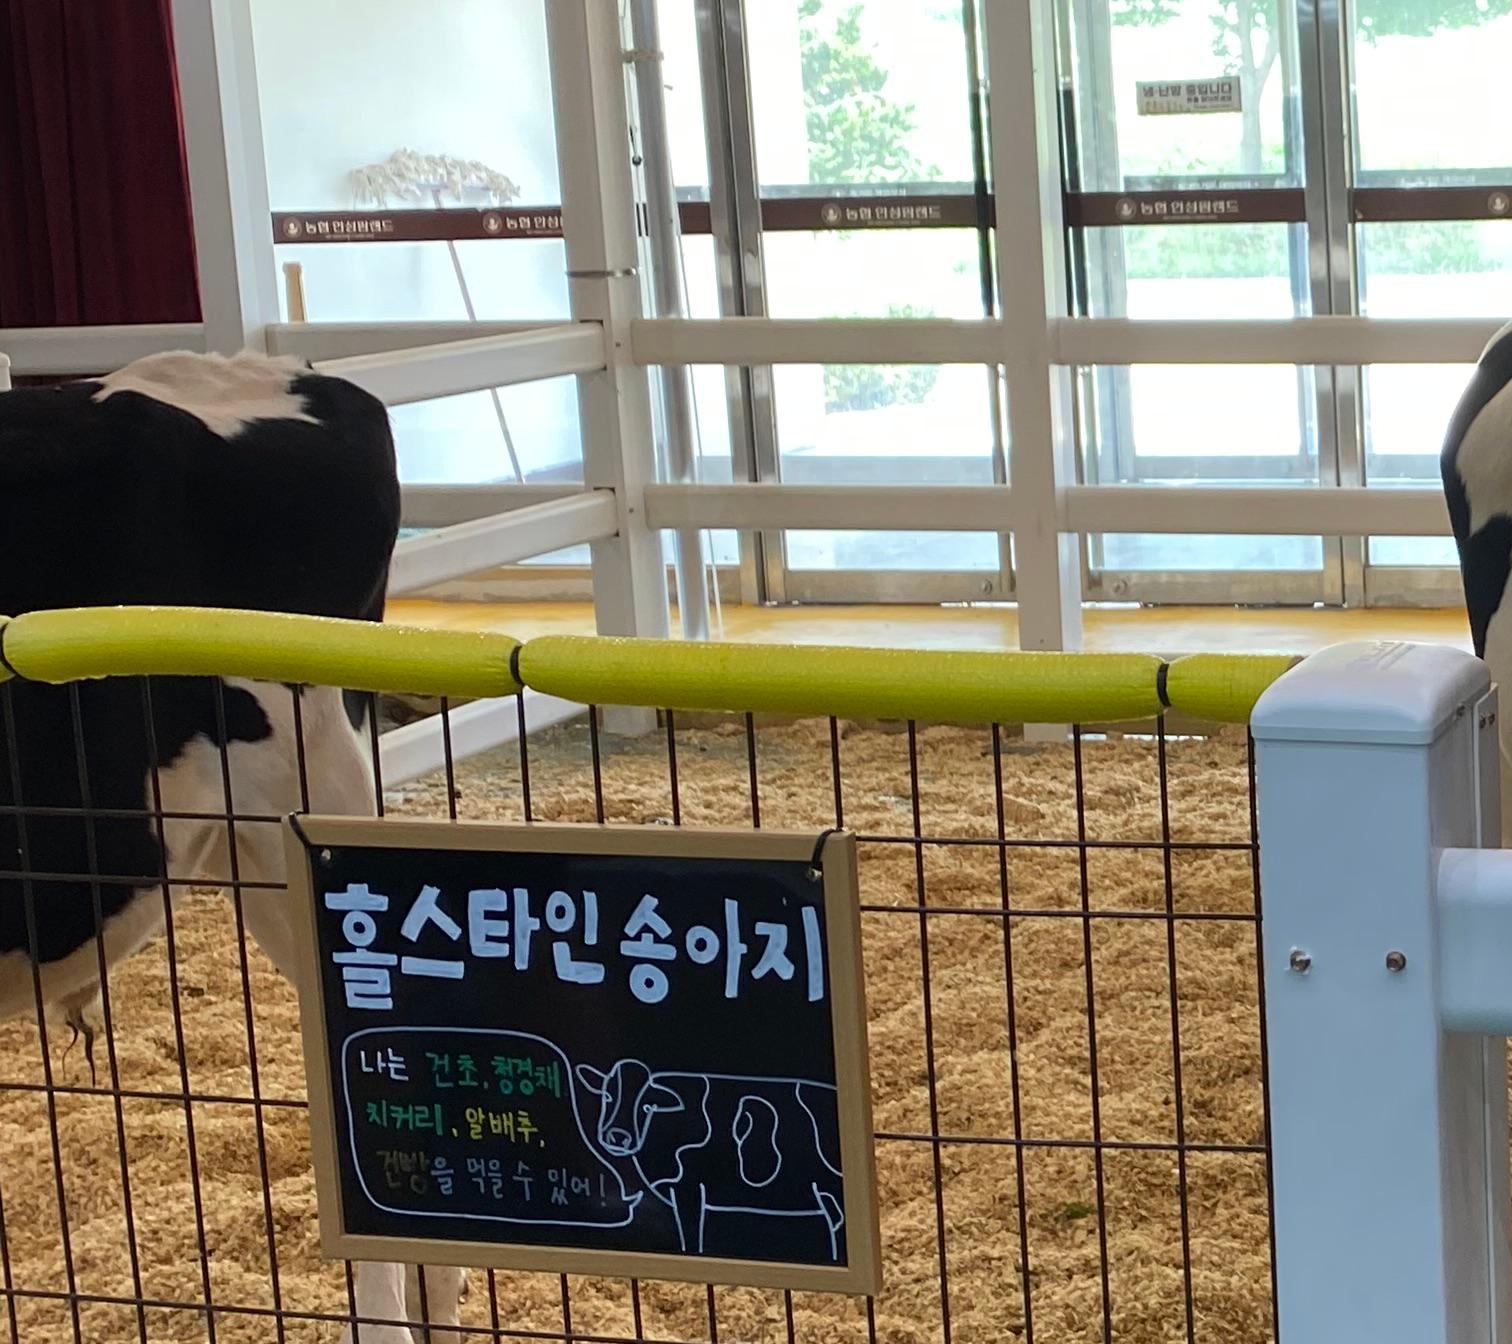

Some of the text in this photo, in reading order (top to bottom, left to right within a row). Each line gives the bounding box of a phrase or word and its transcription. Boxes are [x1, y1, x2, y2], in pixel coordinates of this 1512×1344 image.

[323, 882, 825, 1010] 홀스타인 송아지
[359, 1047, 410, 1083] 나는
[490, 1054, 563, 1099] 청경채
[466, 1156, 505, 1201] 먹을
[511, 1161, 535, 1202] 수
[546, 1167, 608, 1208] 있어!
